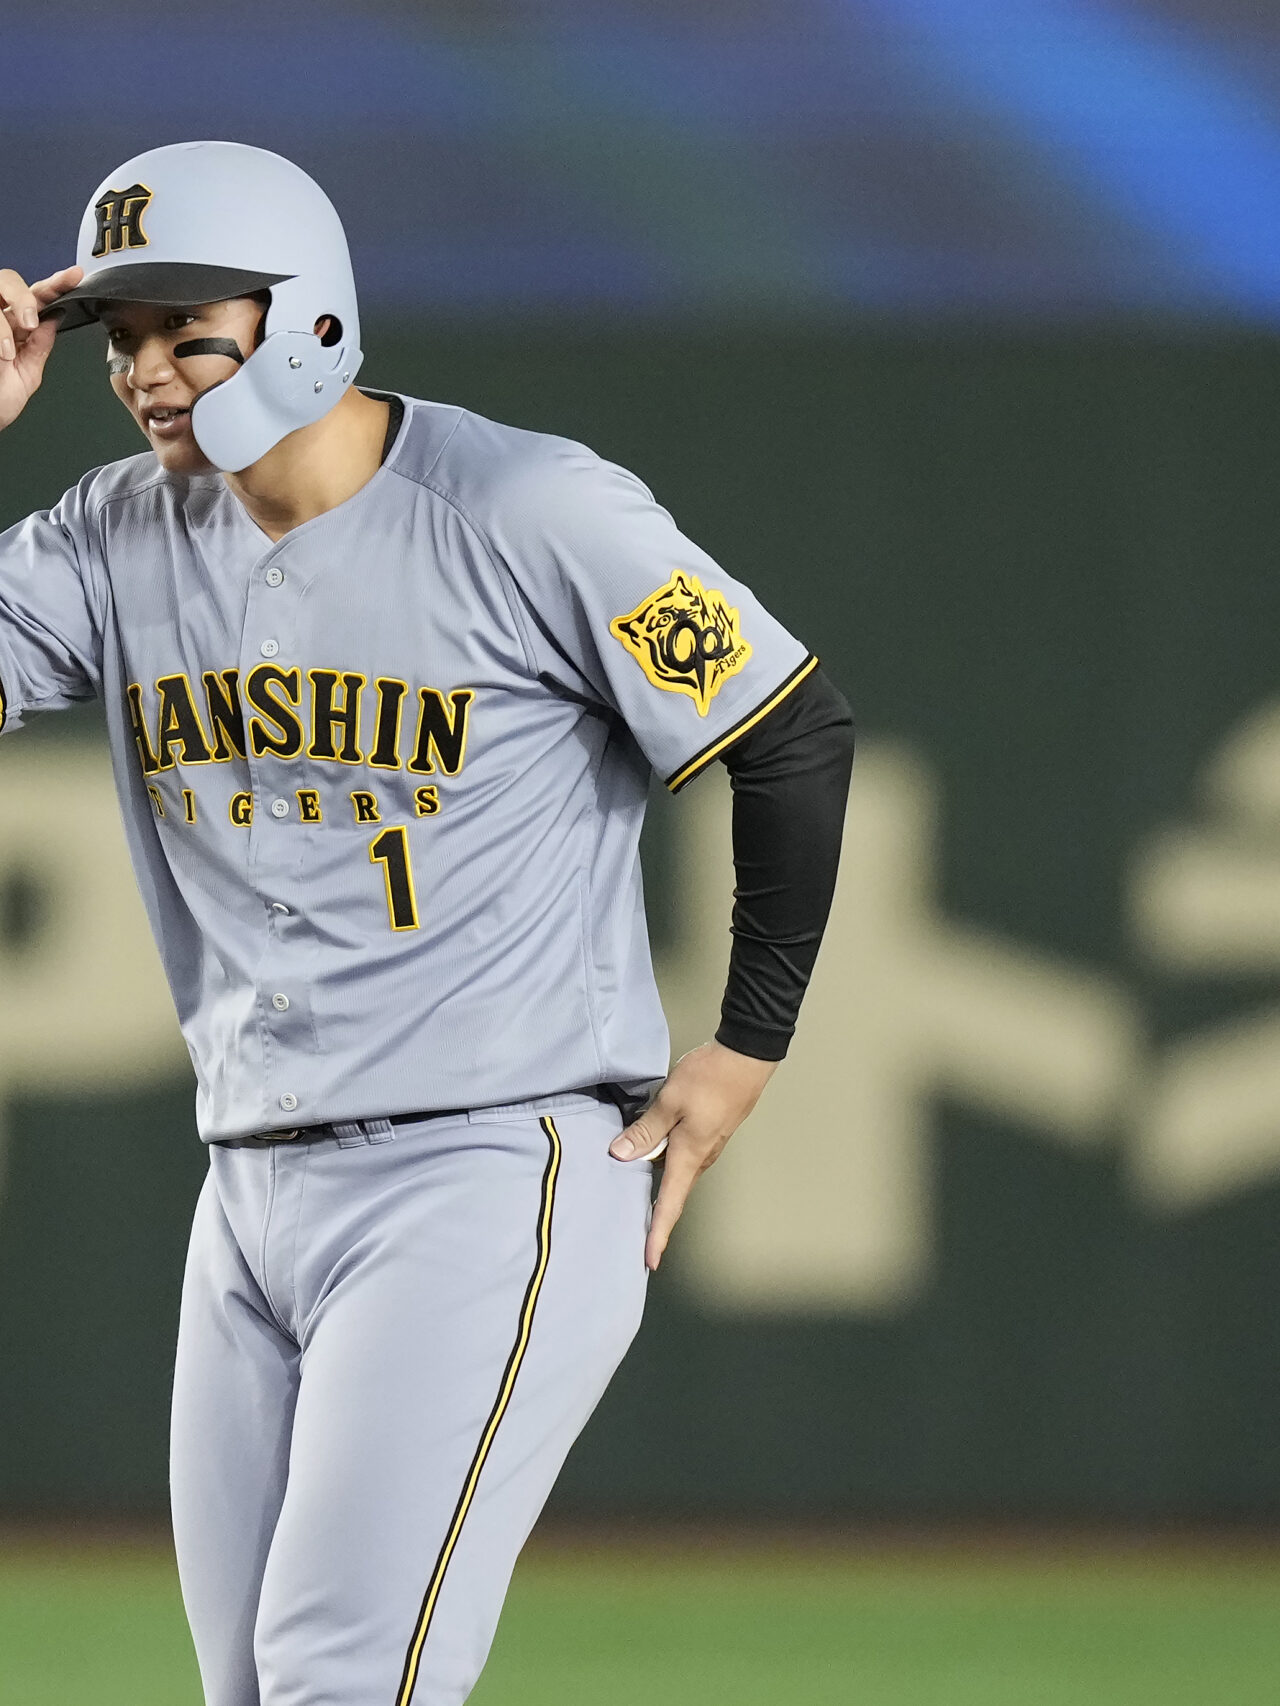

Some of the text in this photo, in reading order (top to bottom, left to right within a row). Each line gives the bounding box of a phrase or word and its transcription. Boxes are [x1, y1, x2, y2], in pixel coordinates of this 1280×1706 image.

[714, 645, 747, 675] Tigers
[127, 662, 476, 776] HANSHIN
[148, 784, 441, 828] TIGERS
[369, 824, 422, 933] 1
